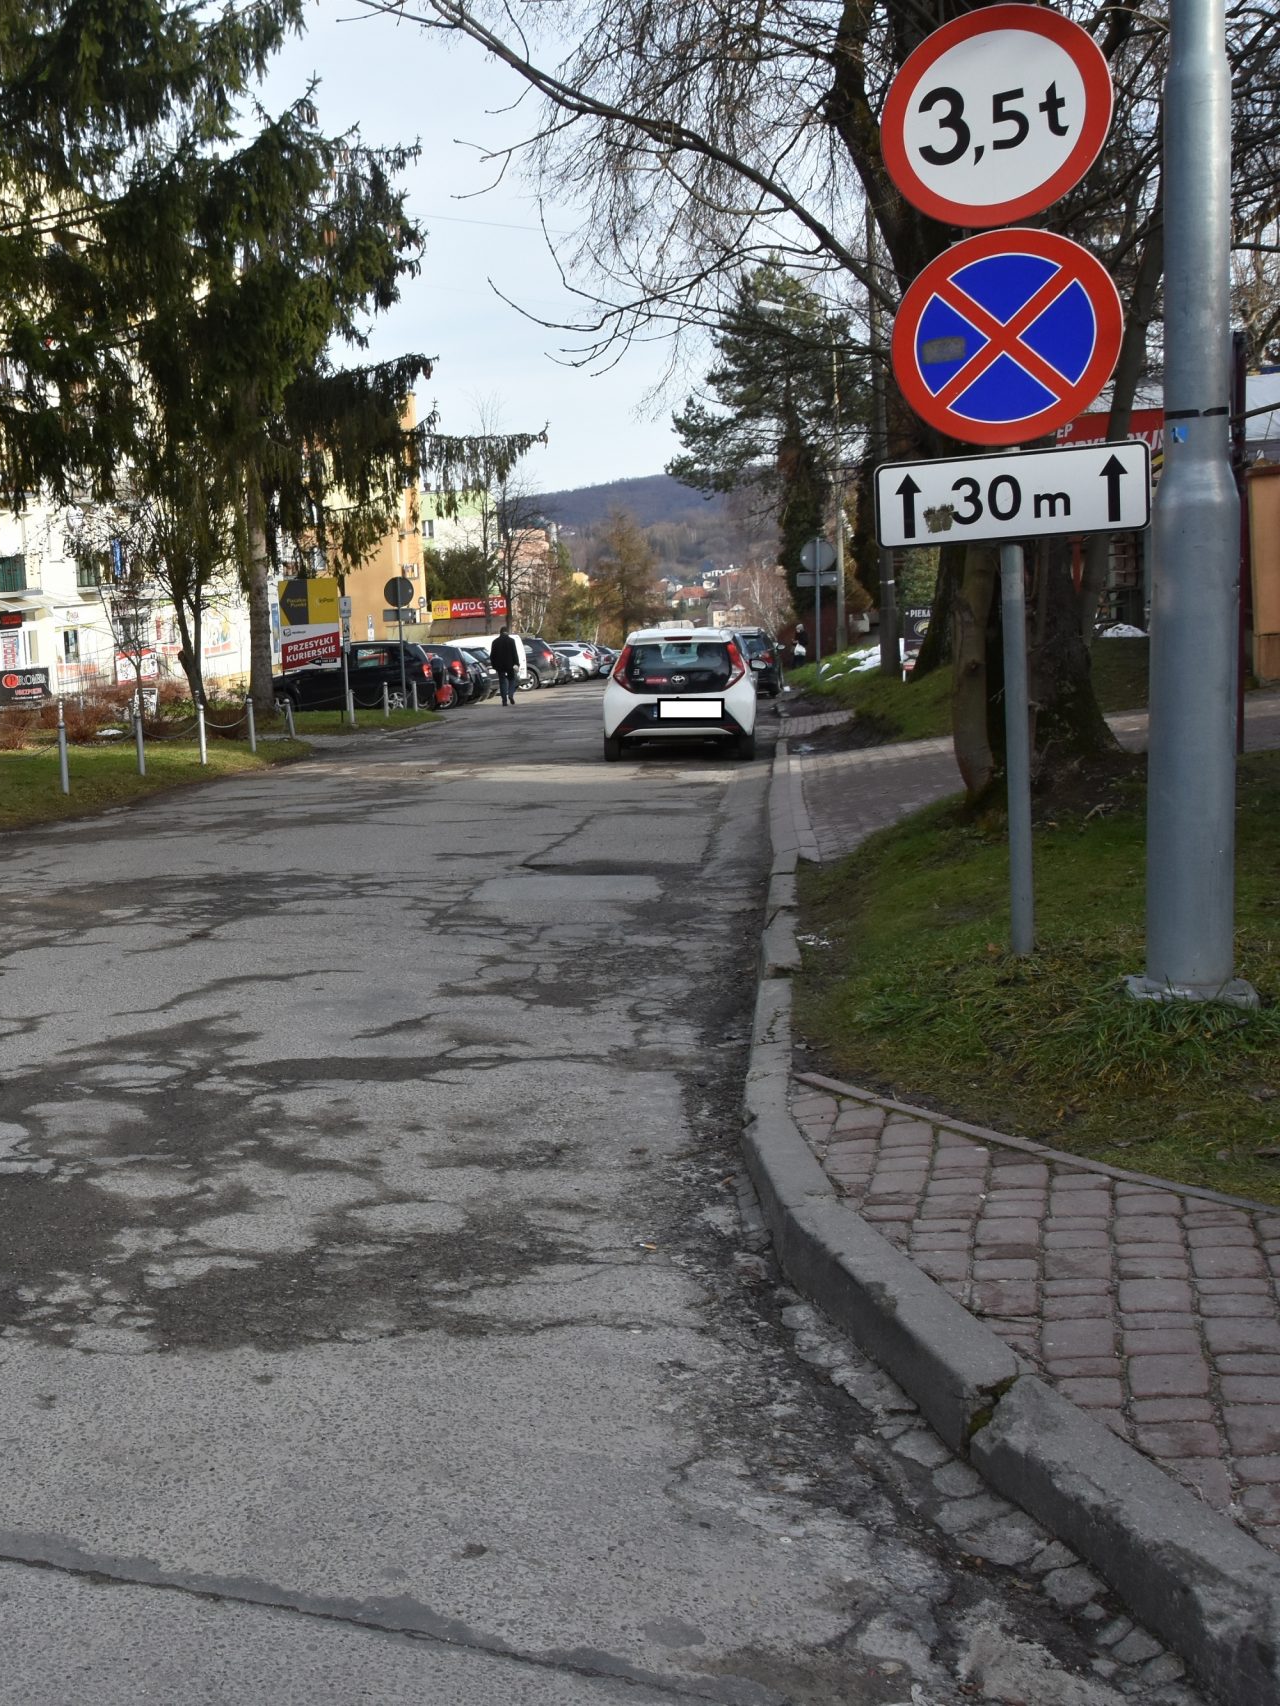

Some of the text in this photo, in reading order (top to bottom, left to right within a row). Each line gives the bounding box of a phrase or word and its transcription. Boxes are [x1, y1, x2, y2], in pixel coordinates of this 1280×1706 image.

[951, 474, 1072, 525] 30 m
[451, 601, 476, 611] AUTO
[477, 598, 507, 611] CĘŚCI
[910, 609, 931, 618] PIEKA
[287, 636, 333, 653] PRZESYŁKI
[286, 644, 336, 663] KURIERSKIE
